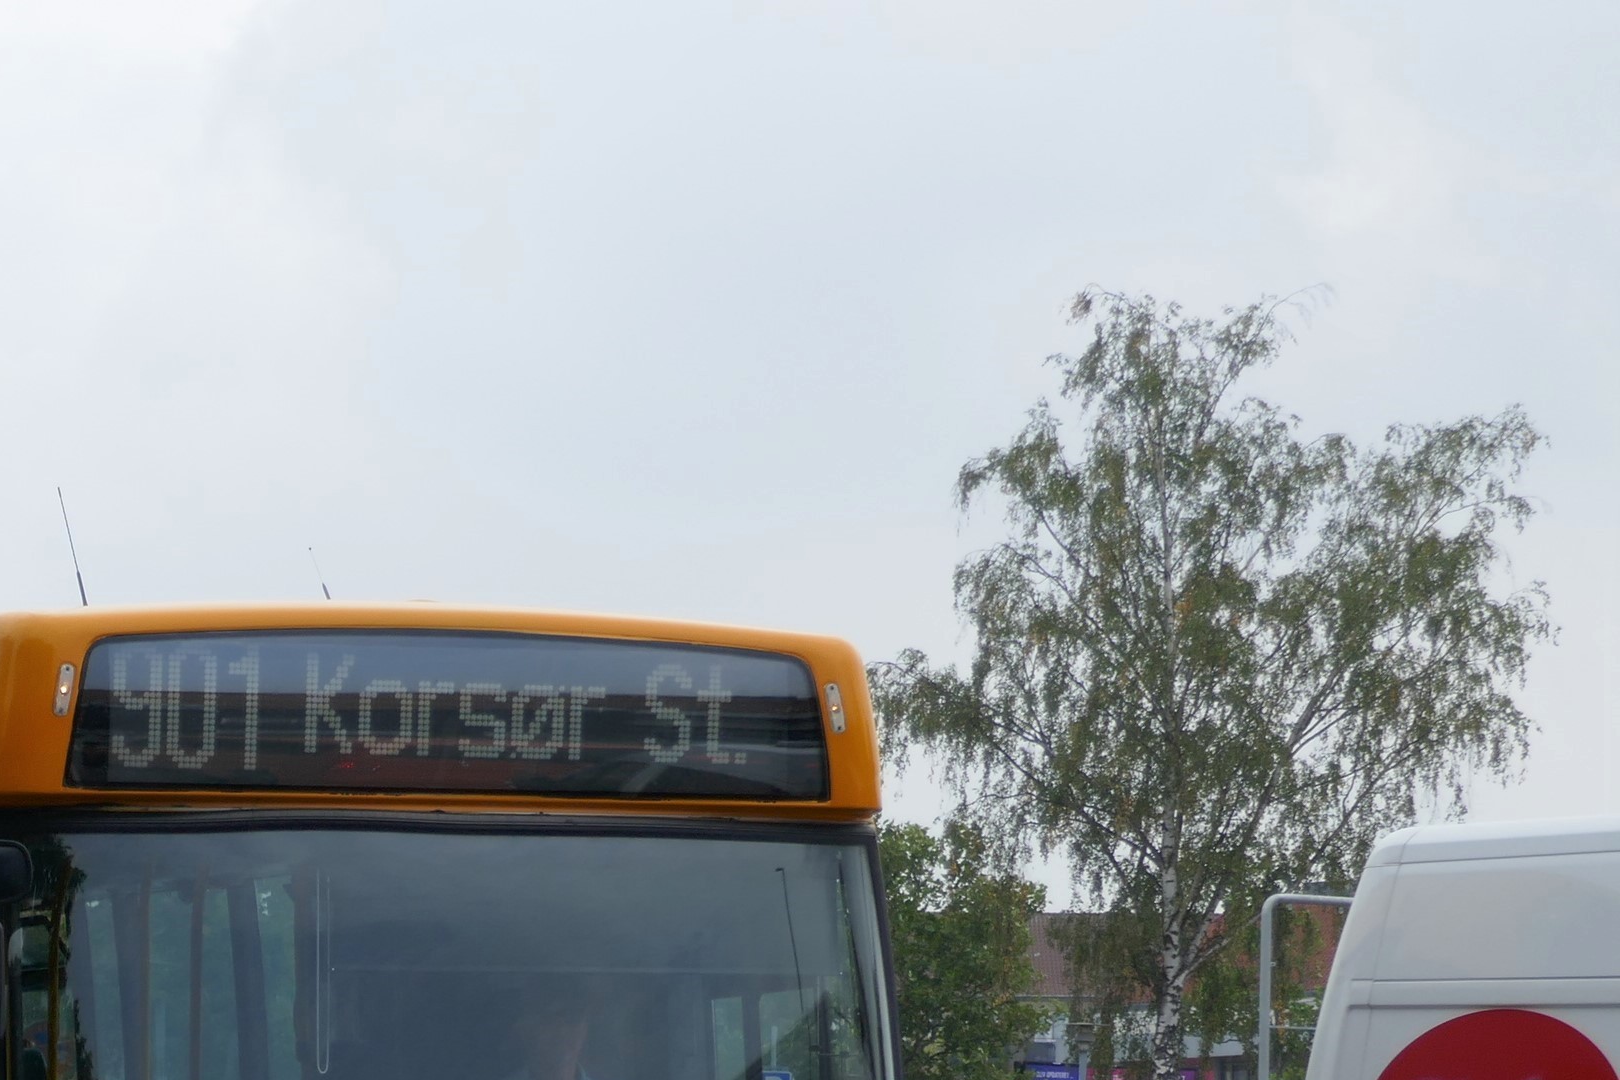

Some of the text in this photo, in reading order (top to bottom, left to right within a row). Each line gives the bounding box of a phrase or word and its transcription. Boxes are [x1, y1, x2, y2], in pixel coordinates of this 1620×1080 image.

[112, 647, 746, 769] 901 Korsør St.
